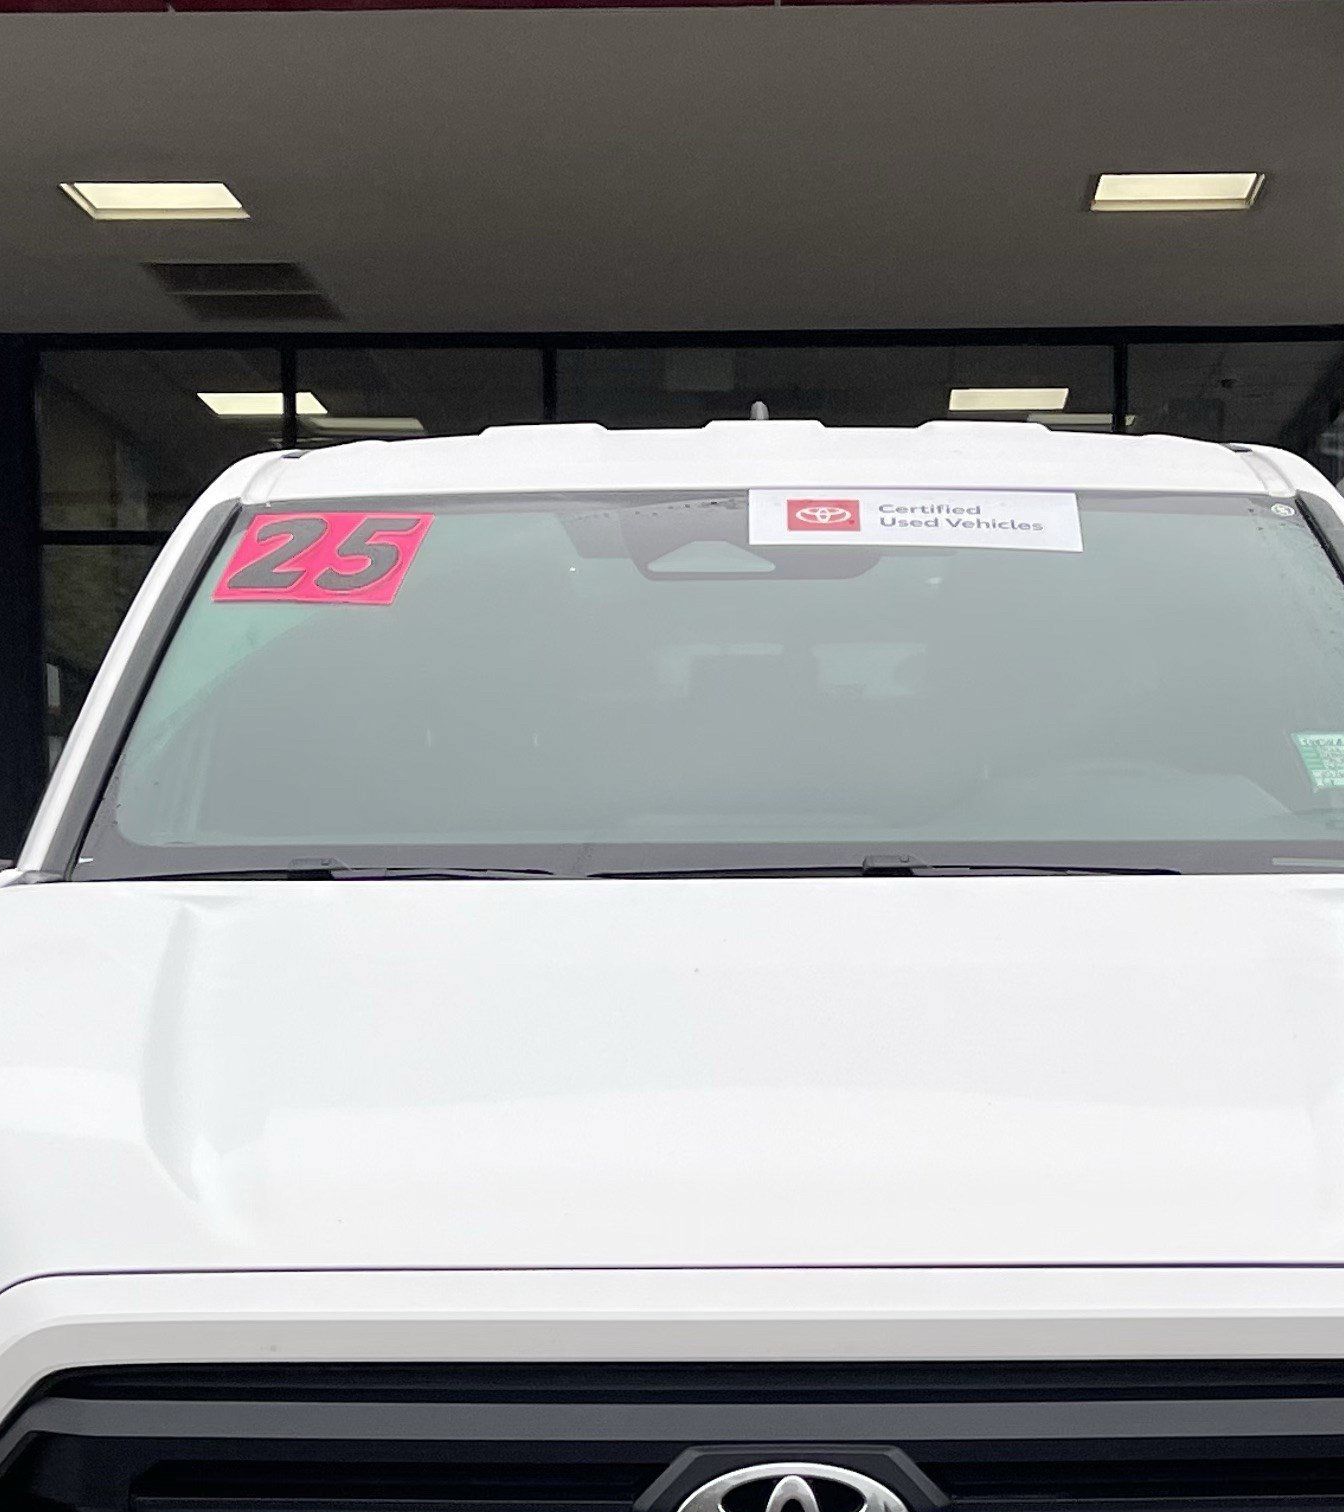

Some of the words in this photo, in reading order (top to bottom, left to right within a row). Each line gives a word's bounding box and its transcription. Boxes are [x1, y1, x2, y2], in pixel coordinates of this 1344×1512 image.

[878, 503, 982, 515] Certified
[880, 517, 940, 528] Used
[946, 517, 1045, 532] Vehicles
[226, 516, 422, 592] 25
